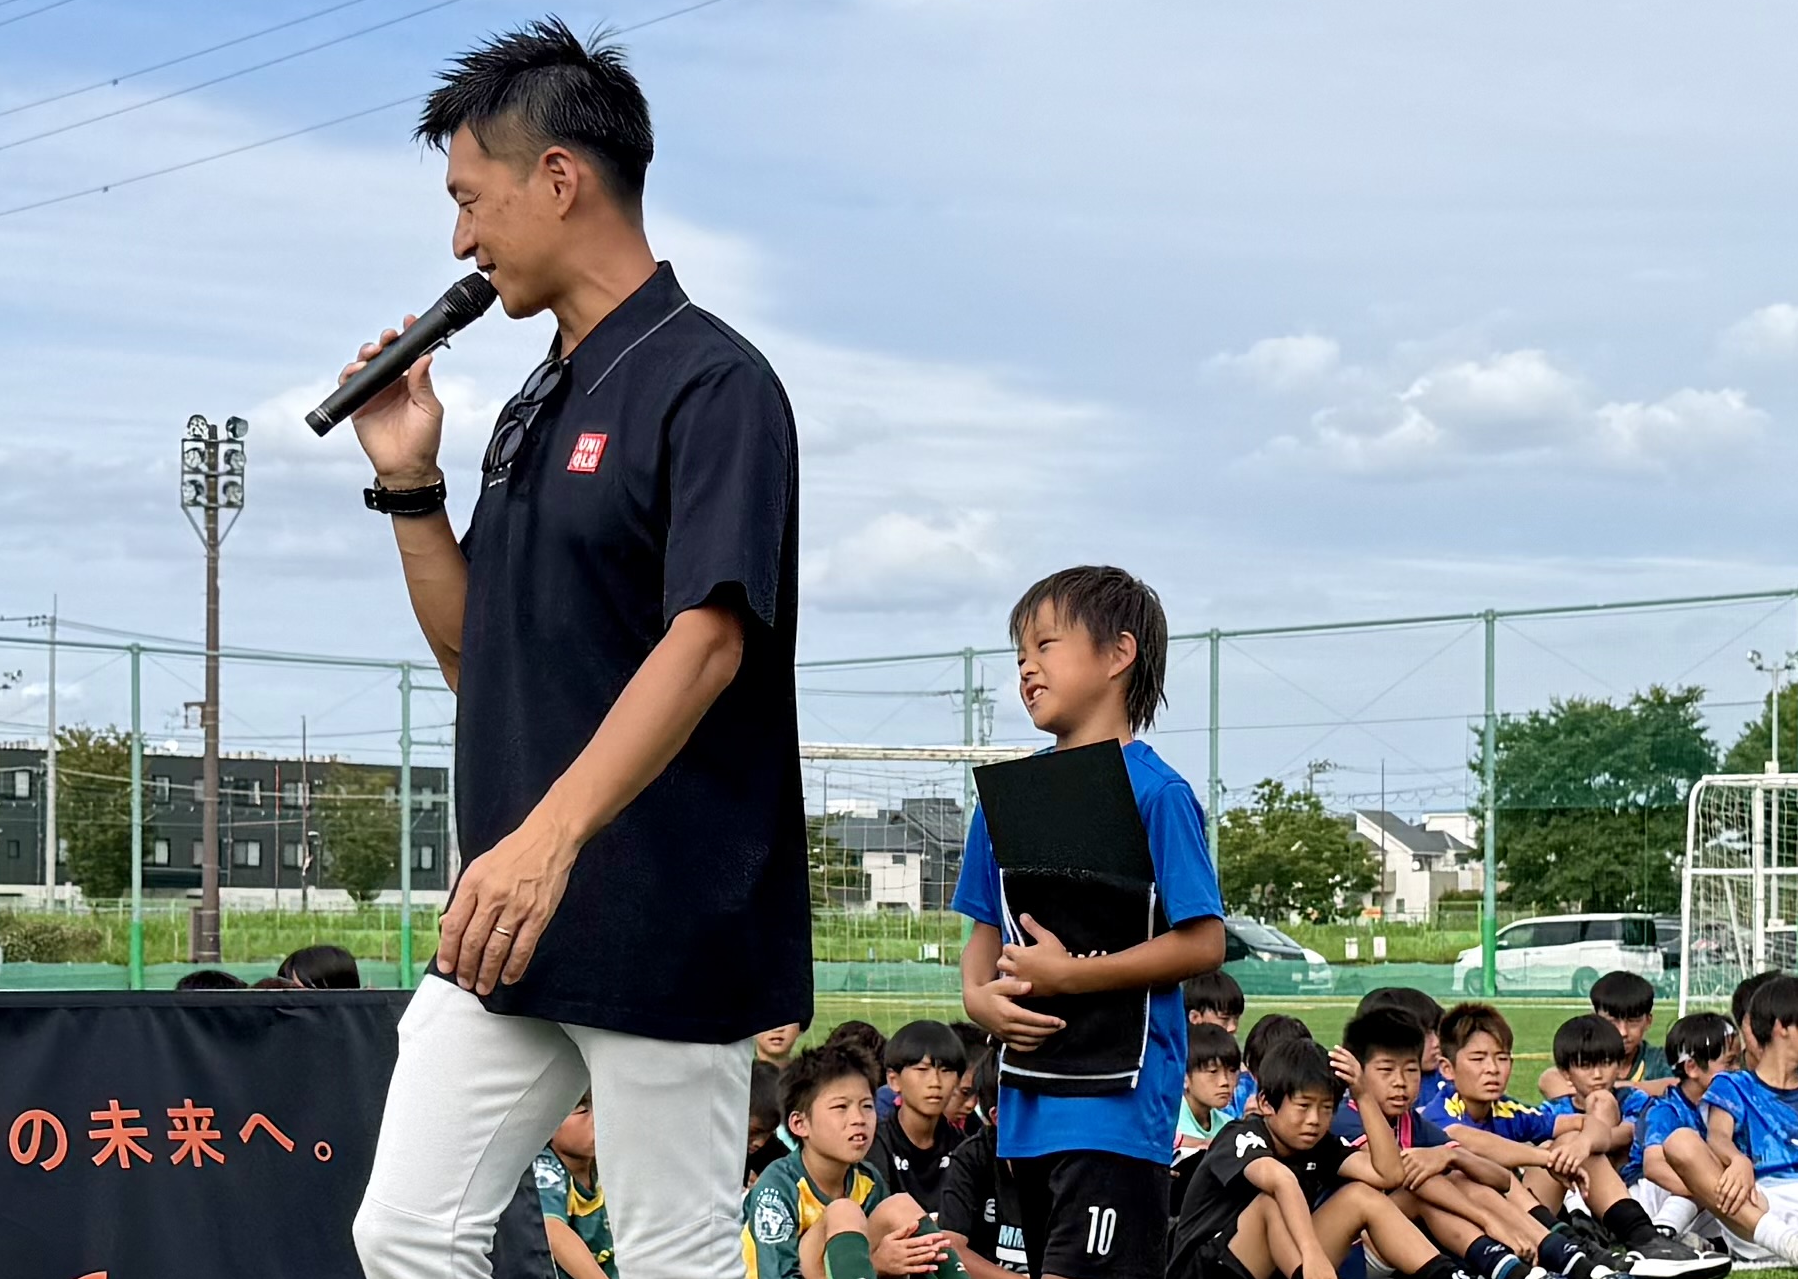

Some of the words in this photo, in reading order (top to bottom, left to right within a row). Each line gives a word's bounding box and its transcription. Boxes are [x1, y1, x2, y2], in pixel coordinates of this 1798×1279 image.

[578, 437, 601, 453] UNI
[572, 452, 598, 468] QLO
[1086, 1205, 1117, 1256] 10
